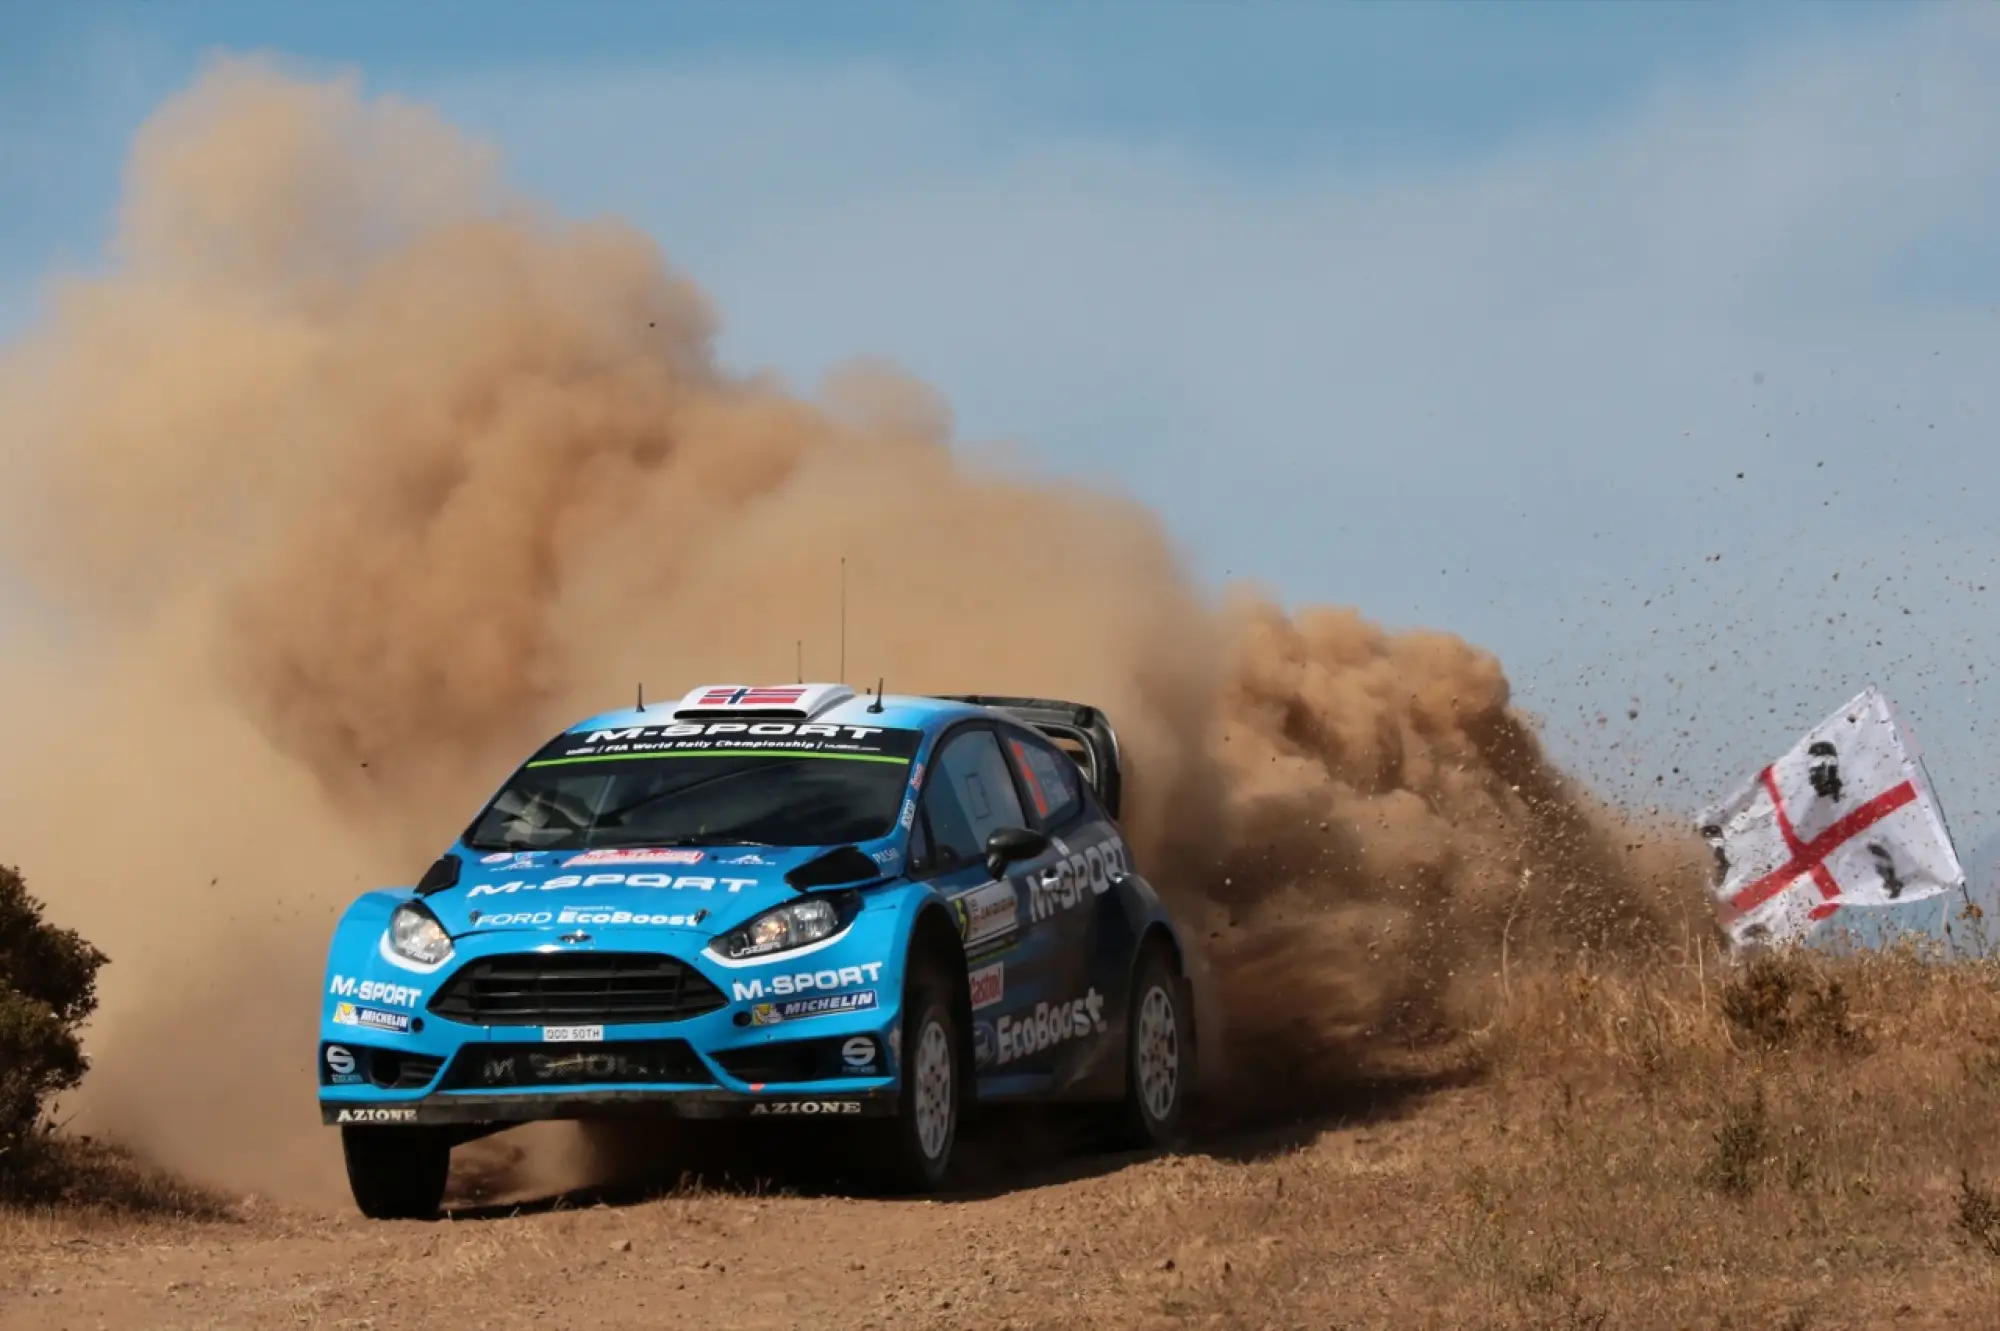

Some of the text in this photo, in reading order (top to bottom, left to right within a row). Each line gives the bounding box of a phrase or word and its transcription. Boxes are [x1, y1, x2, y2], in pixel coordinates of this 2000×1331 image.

[585, 723, 883, 743] M-SPORT
[605, 743, 629, 752] FIA
[632, 741, 673, 750] World
[675, 739, 712, 749] Rally
[715, 739, 815, 749] Championship
[466, 874, 758, 897] M-SPORT
[475, 911, 699, 927] FORD EcoBoost
[330, 975, 422, 1008] M-SPORT
[732, 961, 883, 1002] M-SPORT
[785, 991, 873, 1014] MICHELIN
[360, 1009, 409, 1028] MICHELIN
[997, 987, 1108, 1065] EcoBoost
[336, 1108, 418, 1122] AZIONE
[750, 1102, 862, 1115] AZIONE
